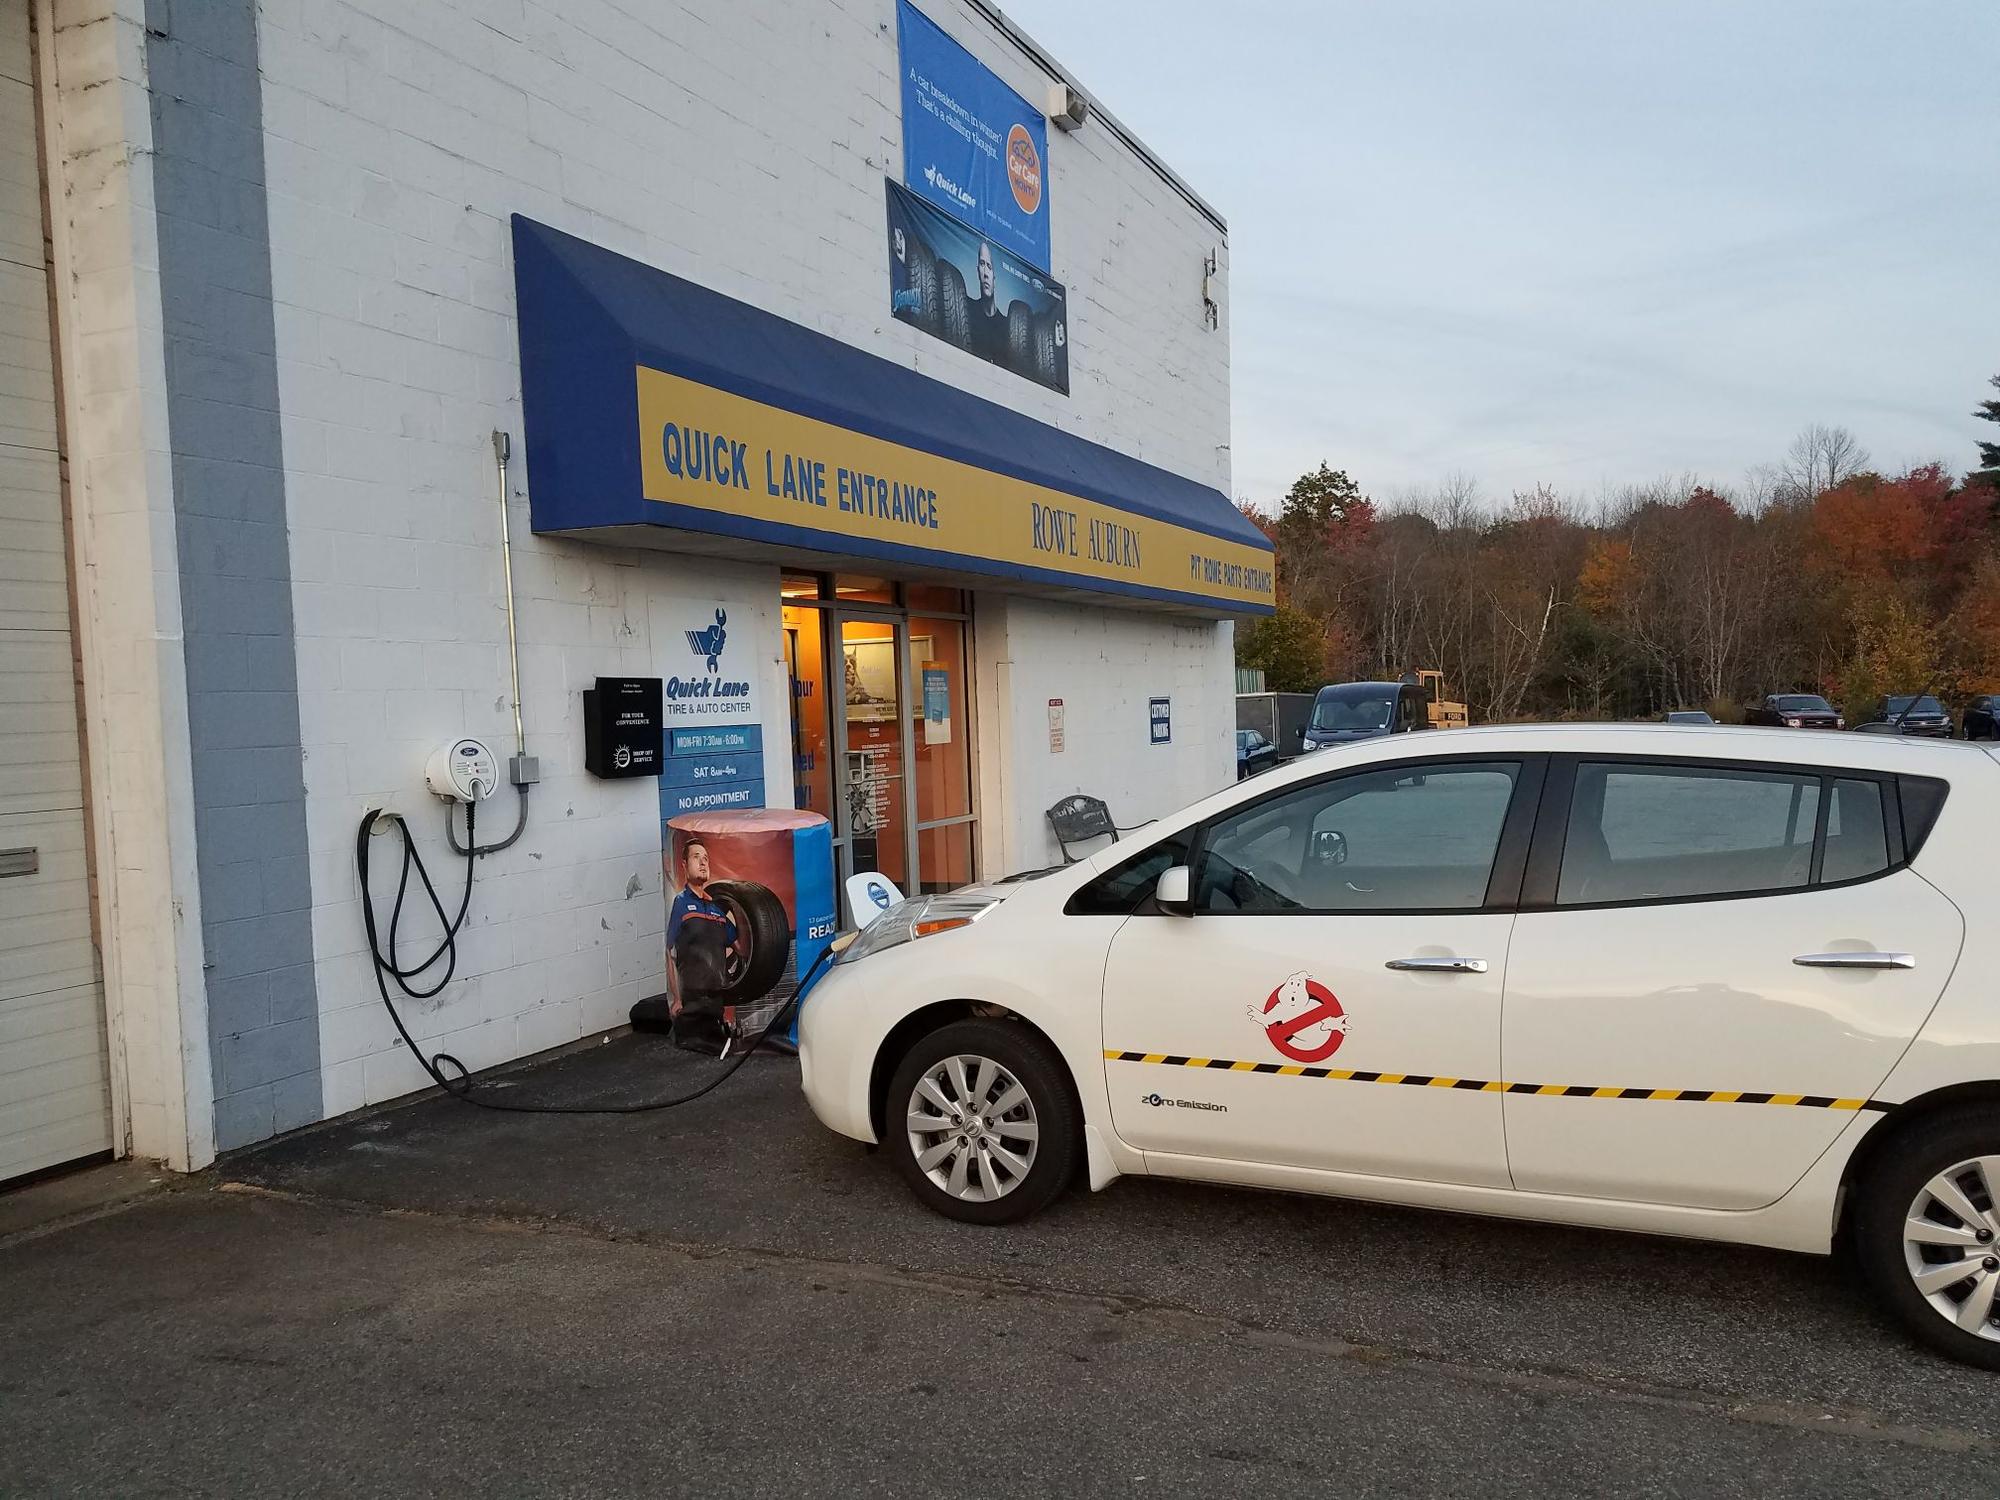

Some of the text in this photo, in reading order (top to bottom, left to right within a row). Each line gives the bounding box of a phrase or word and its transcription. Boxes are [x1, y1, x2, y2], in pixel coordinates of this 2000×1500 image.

[909, 67, 1003, 145] A car breakdown in winter?
[916, 89, 939, 117] That's
[940, 110, 945, 122] a
[946, 114, 971, 142] chilling
[936, 172, 958, 196] Quick
[958, 187, 976, 208] Lane
[1010, 155, 1039, 190] Car Care
[662, 421, 938, 529] QUICK LANE ENTRANCE
[1031, 502, 1141, 570] ROWE AUBURN
[1190, 554, 1271, 593] PIT ROWE PARTS ENTRANCE
[666, 676, 750, 700] Quick Lane
[667, 702, 751, 715] TIRE & AUTO CENTER
[677, 736, 702, 748] MON-FRI
[693, 767, 709, 778] SAT
[679, 791, 750, 809] NO APPOINTMENT
[1177, 1099, 1228, 1112] Emission
